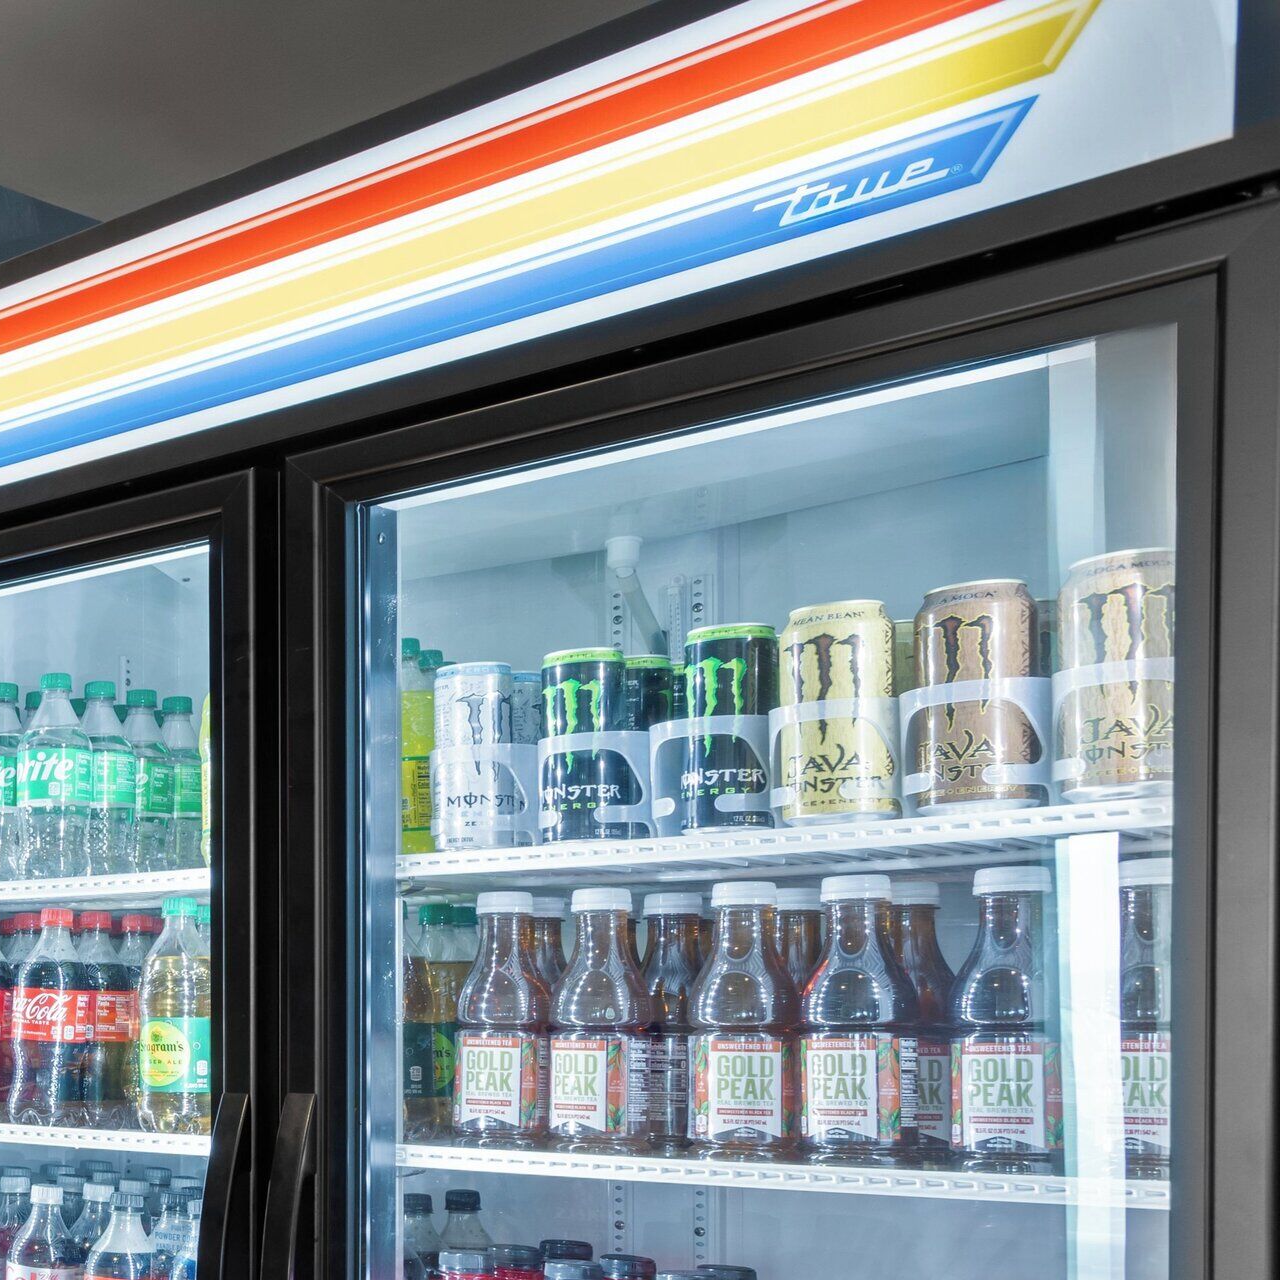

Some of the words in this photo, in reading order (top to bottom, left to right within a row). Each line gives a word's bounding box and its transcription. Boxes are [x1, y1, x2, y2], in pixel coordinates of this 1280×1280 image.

[949, 590, 993, 601] MOCA
[828, 610, 861, 622] BEAN
[466, 1050, 513, 1071] GOLD
[554, 1054, 598, 1075] GOLD
[716, 1055, 775, 1078] GOLD
[811, 1053, 867, 1078] GOLD
[968, 1057, 1034, 1083] GOLD
[466, 1071, 513, 1092] PEAK
[554, 1075, 598, 1097] PEAK
[716, 1078, 775, 1101] PEAK
[811, 1077, 869, 1101] PEAK
[968, 1082, 1035, 1108] PEAK
